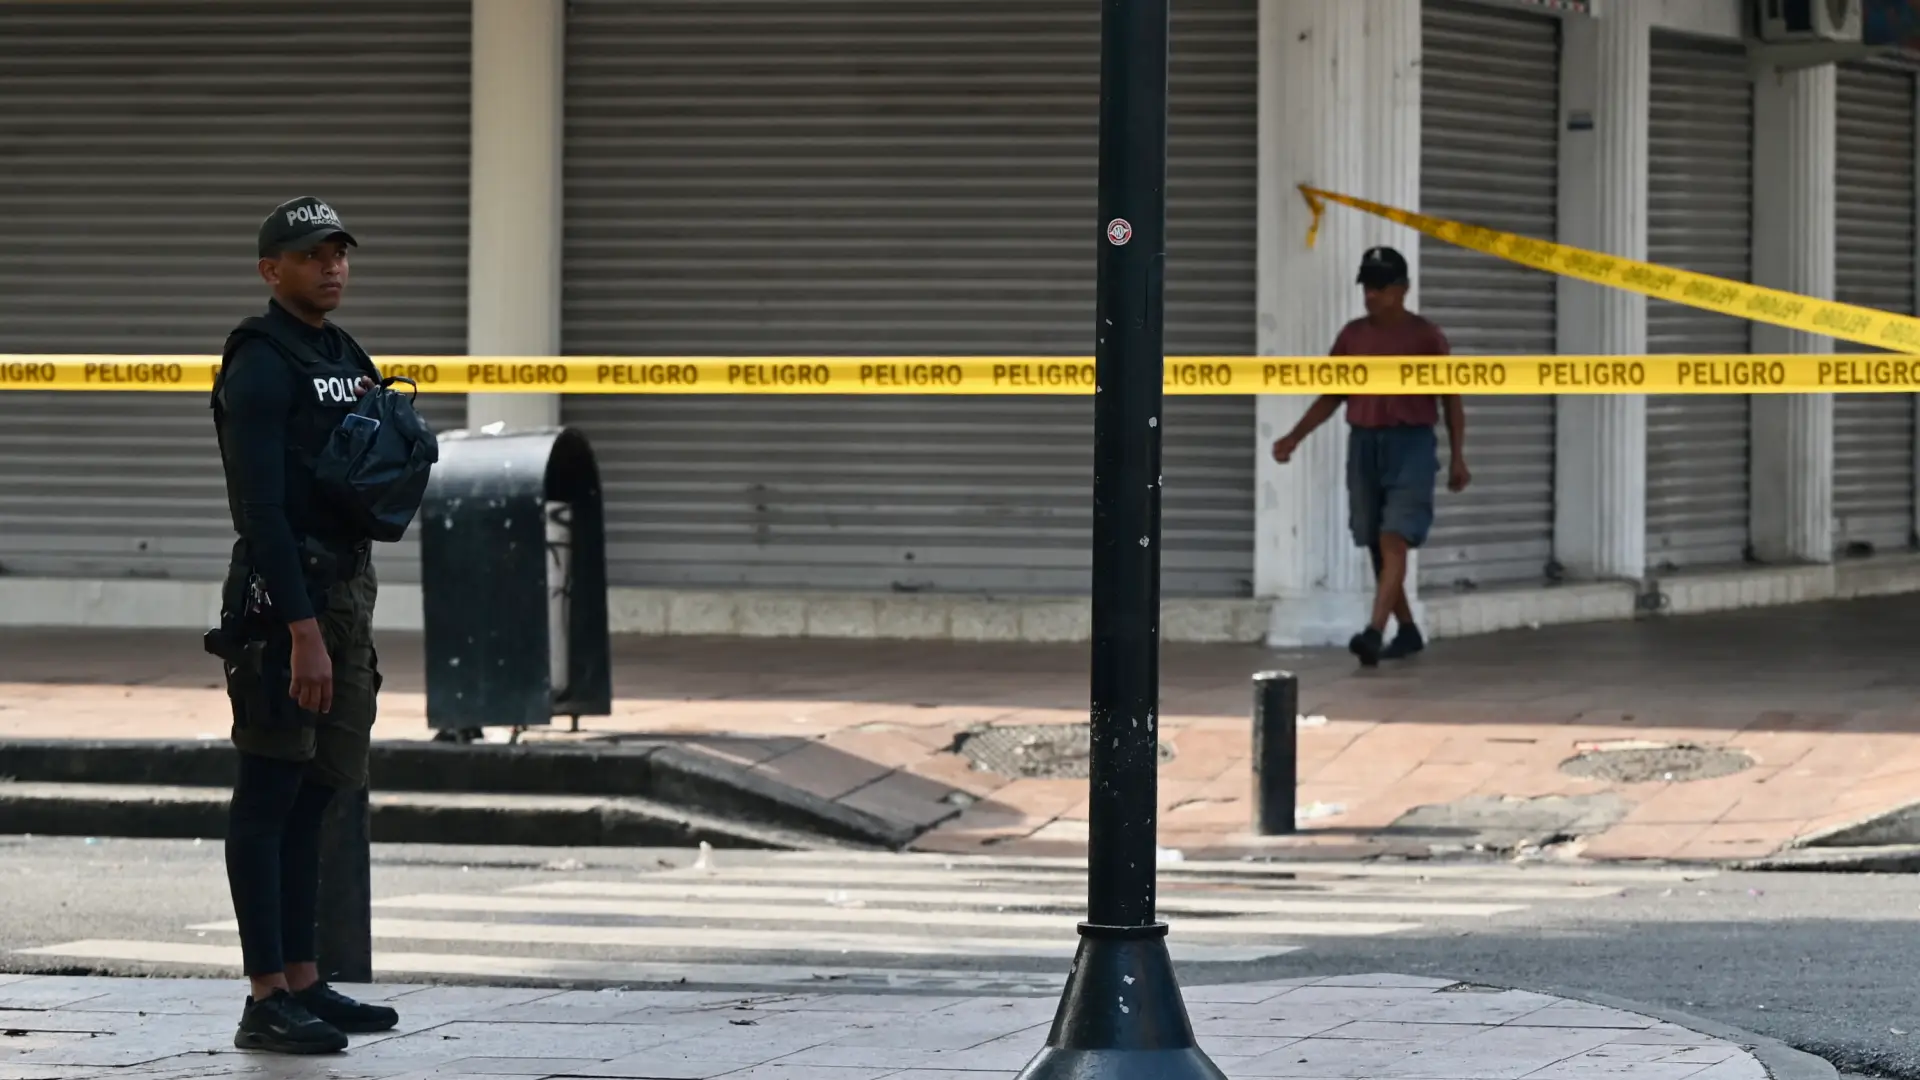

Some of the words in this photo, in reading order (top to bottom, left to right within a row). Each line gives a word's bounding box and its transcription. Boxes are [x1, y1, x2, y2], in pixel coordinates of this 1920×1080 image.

[0, 362, 56, 382] IGRO
[84, 362, 183, 383] PELIGRO
[380, 364, 438, 384] IGRO
[467, 364, 568, 384] PELIGRO
[597, 364, 698, 384] PELIGRO
[728, 364, 829, 384] PELIGRO
[860, 364, 962, 384] PELIGRO
[994, 364, 1096, 385] PELIGRO
[1163, 363, 1233, 385] IGRO
[1263, 364, 1367, 385] PELIGRO
[1400, 364, 1506, 385] PELIGRO
[1538, 363, 1645, 385] PELIGRO
[1678, 362, 1785, 385] PELIGRO
[1817, 362, 1920, 385] PELIGRO
[313, 377, 361, 402] POLI
